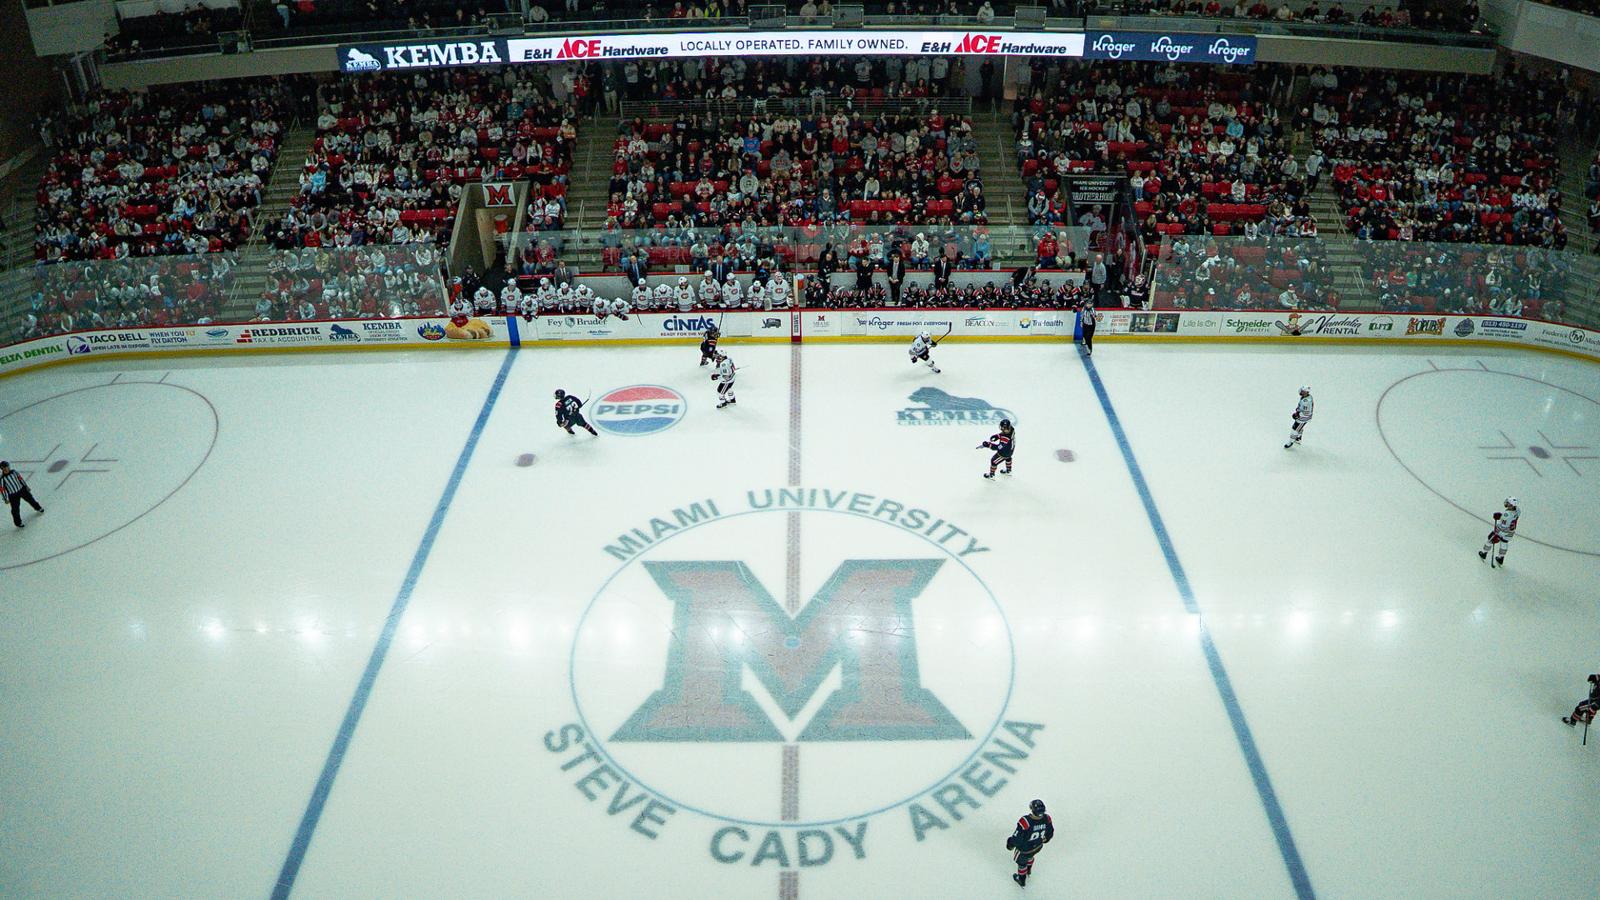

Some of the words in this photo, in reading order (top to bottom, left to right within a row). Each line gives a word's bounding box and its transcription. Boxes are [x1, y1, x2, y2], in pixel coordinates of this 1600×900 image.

[524, 49, 552, 60] E&H
[557, 38, 601, 59] ACE
[603, 46, 669, 56] Hardware
[680, 40, 732, 51] LOCALLY
[736, 39, 804, 51] OPERATED.
[808, 39, 853, 50] FAMILY
[857, 39, 909, 50] OWNED.
[921, 42, 951, 53] E&H
[954, 32, 1002, 53] ACE
[1001, 43, 1067, 54] Hardware
[1093, 34, 1136, 59] Kroger
[1151, 36, 1193, 61] Kroger
[1208, 38, 1251, 63] Kroger
[384, 41, 502, 68] KEMBA
[484, 185, 513, 205] M
[251, 327, 320, 336] REDBRICK
[363, 322, 403, 330] KEMBA
[547, 319, 562, 327] Fey
[869, 317, 894, 329] Kroger
[1226, 319, 1272, 327] Schneider
[1315, 314, 1361, 334] Vandalia
[86, 334, 117, 344] TACO
[118, 332, 147, 342] BELL
[23, 344, 64, 358] DENTAL
[597, 404, 680, 415] PEPSI
[896, 410, 1008, 421] KEMBA
[603, 498, 721, 561] MIAMI
[747, 488, 991, 558] UNIVERSITY
[543, 723, 678, 840] STEVE
[710, 821, 868, 867] CADY
[908, 720, 1046, 842] ARENA
